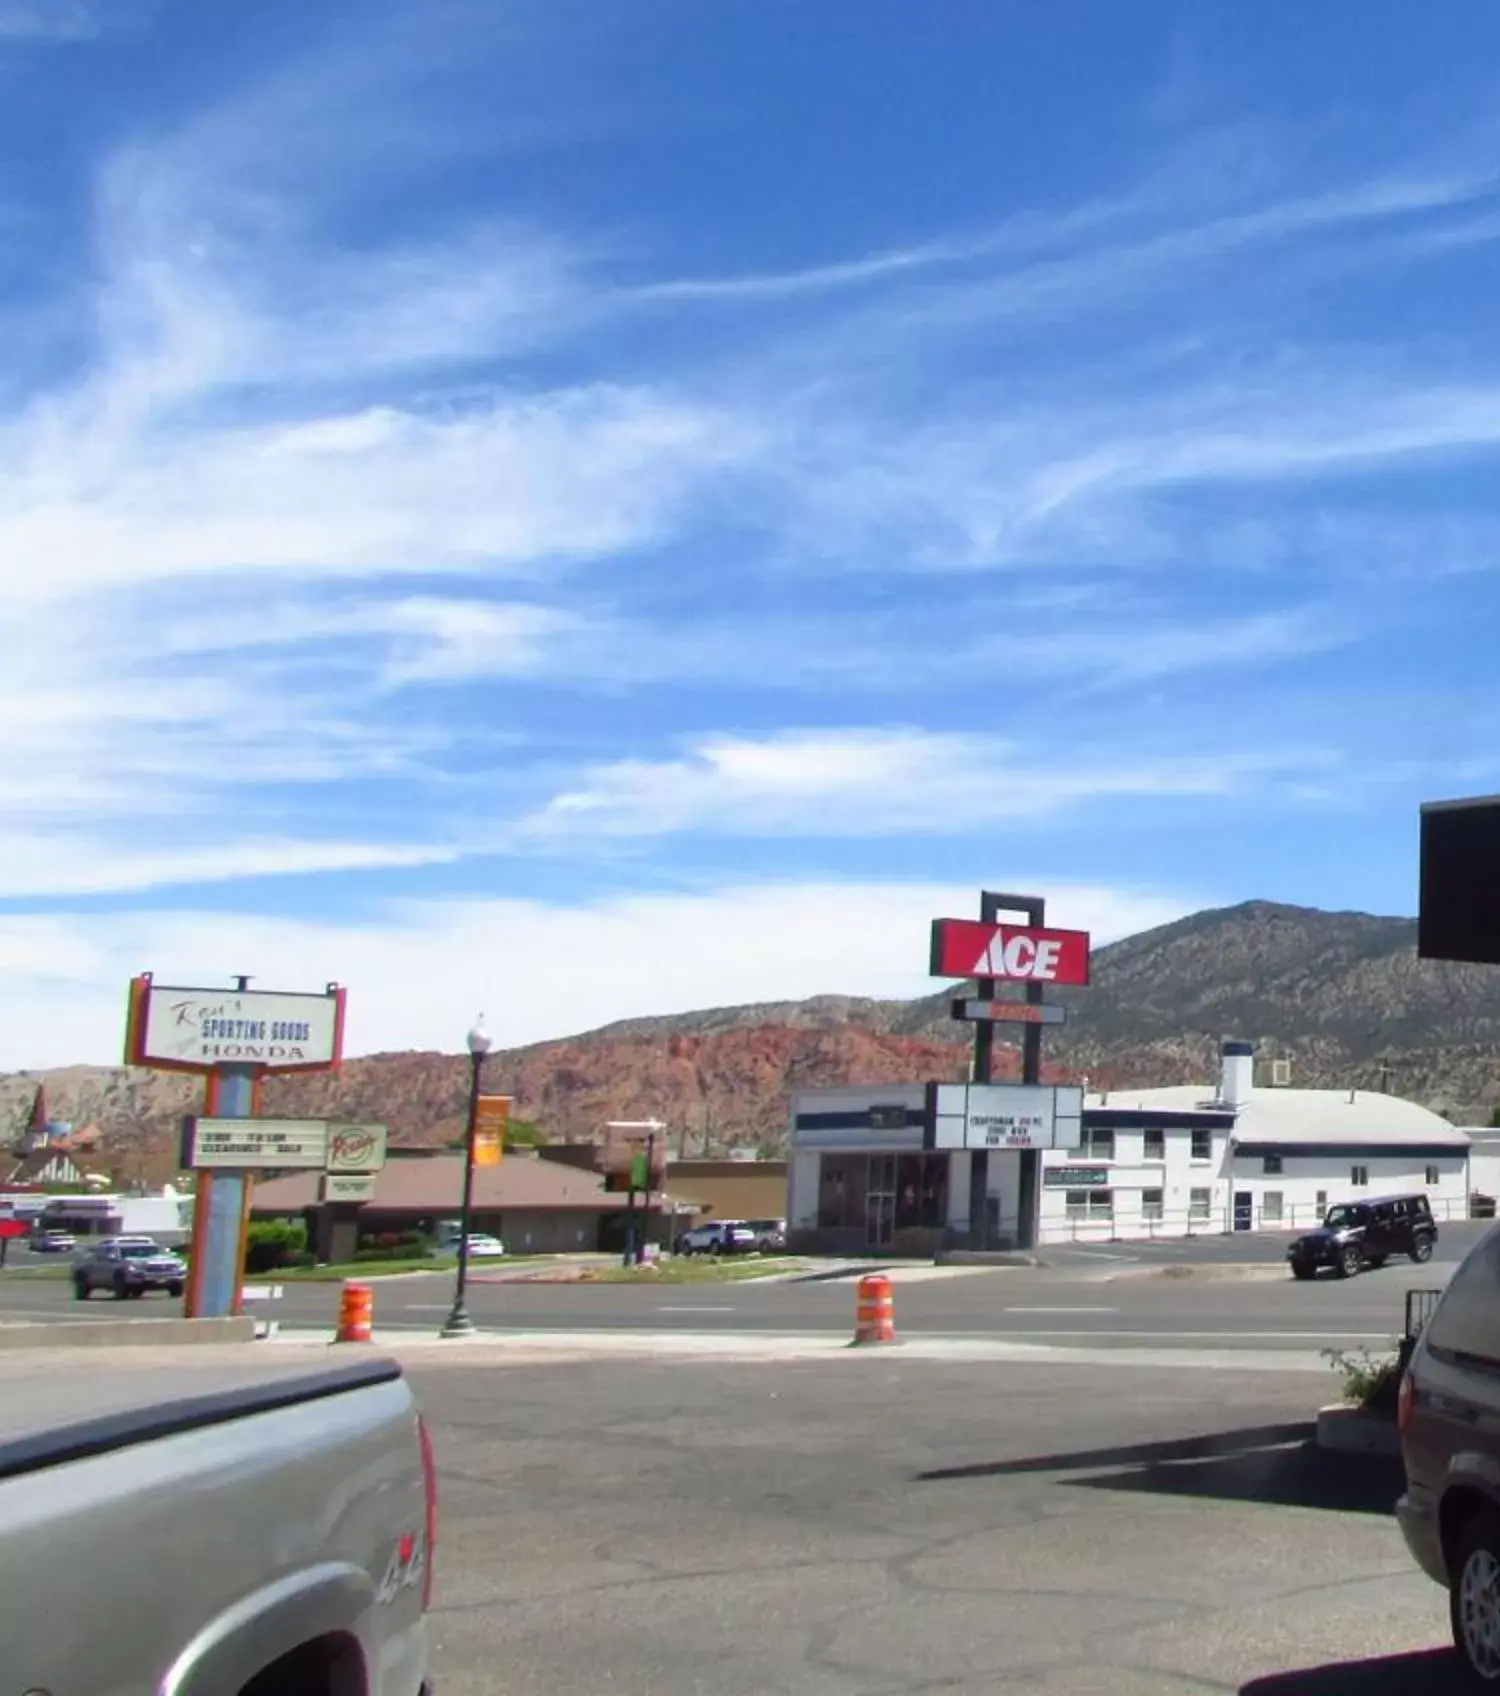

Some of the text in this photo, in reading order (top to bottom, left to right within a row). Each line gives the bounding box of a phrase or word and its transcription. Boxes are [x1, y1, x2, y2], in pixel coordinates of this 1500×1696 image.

[972, 928, 1063, 980] ACE
[202, 1019, 311, 1041] SPORTING GOODS
[202, 1043, 305, 1059] HONDA
